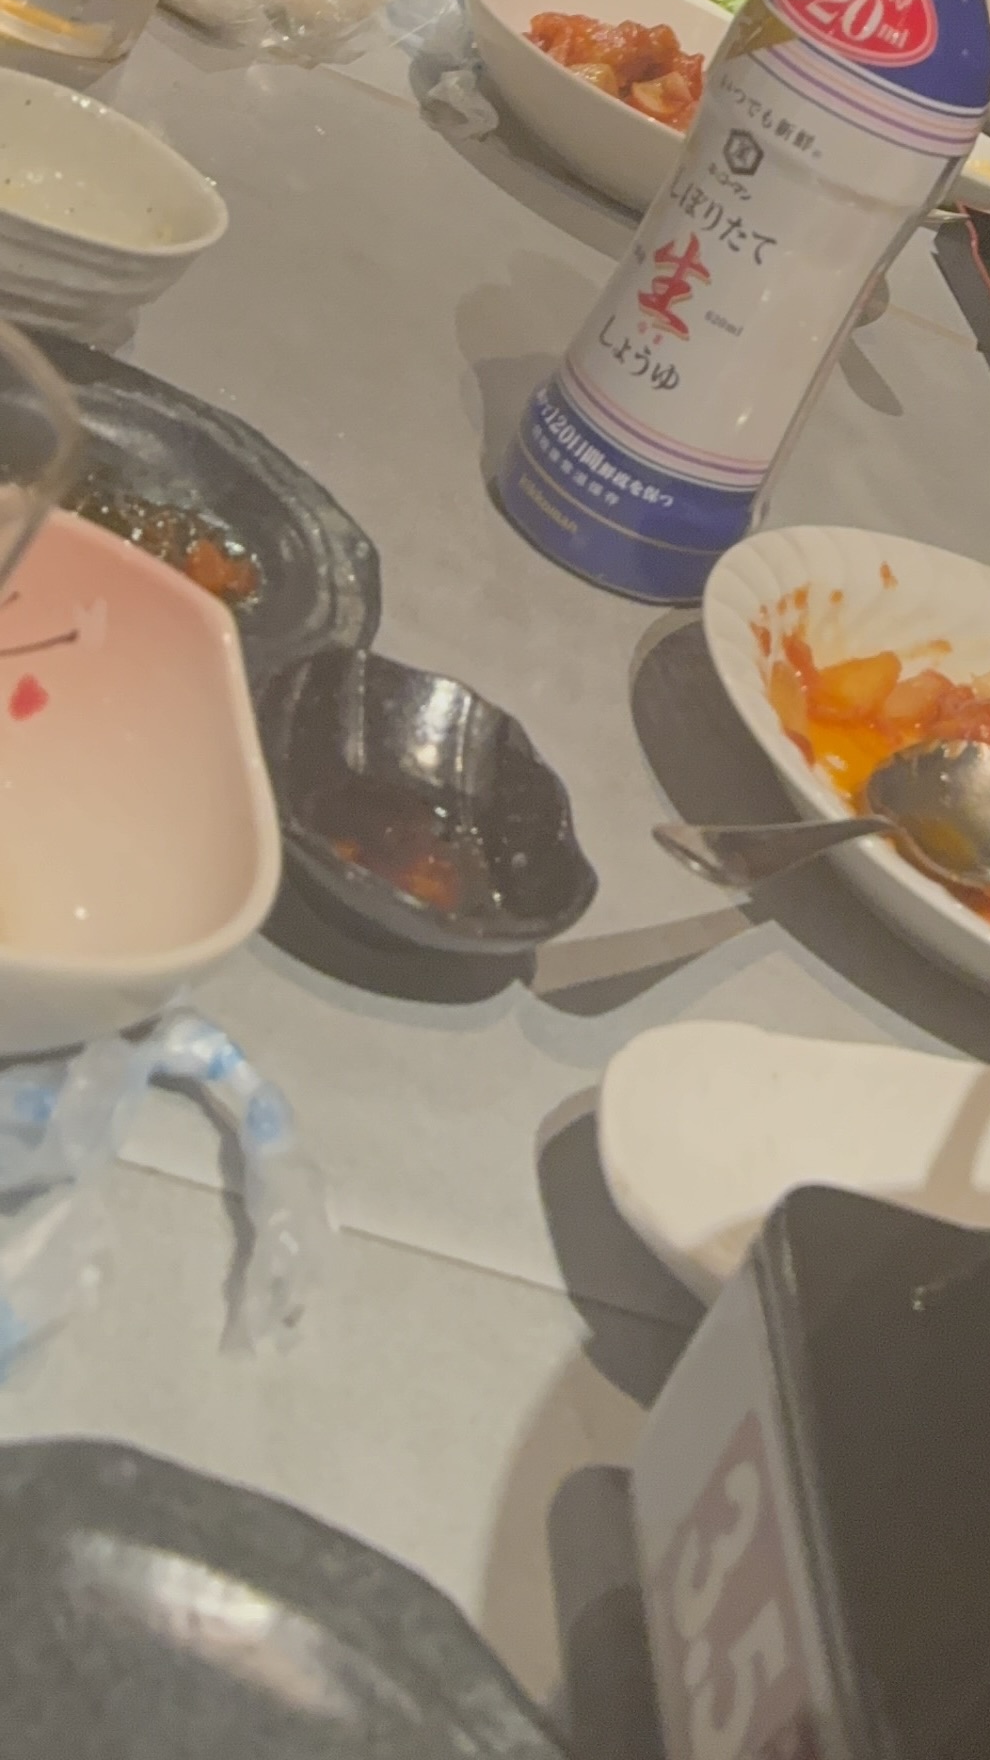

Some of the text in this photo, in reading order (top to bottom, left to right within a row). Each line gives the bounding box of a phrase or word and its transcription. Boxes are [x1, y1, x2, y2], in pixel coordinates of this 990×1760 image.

[667, 164, 778, 269] しぼりたて
[637, 230, 713, 343] 生
[599, 314, 681, 394] しょうゆ
